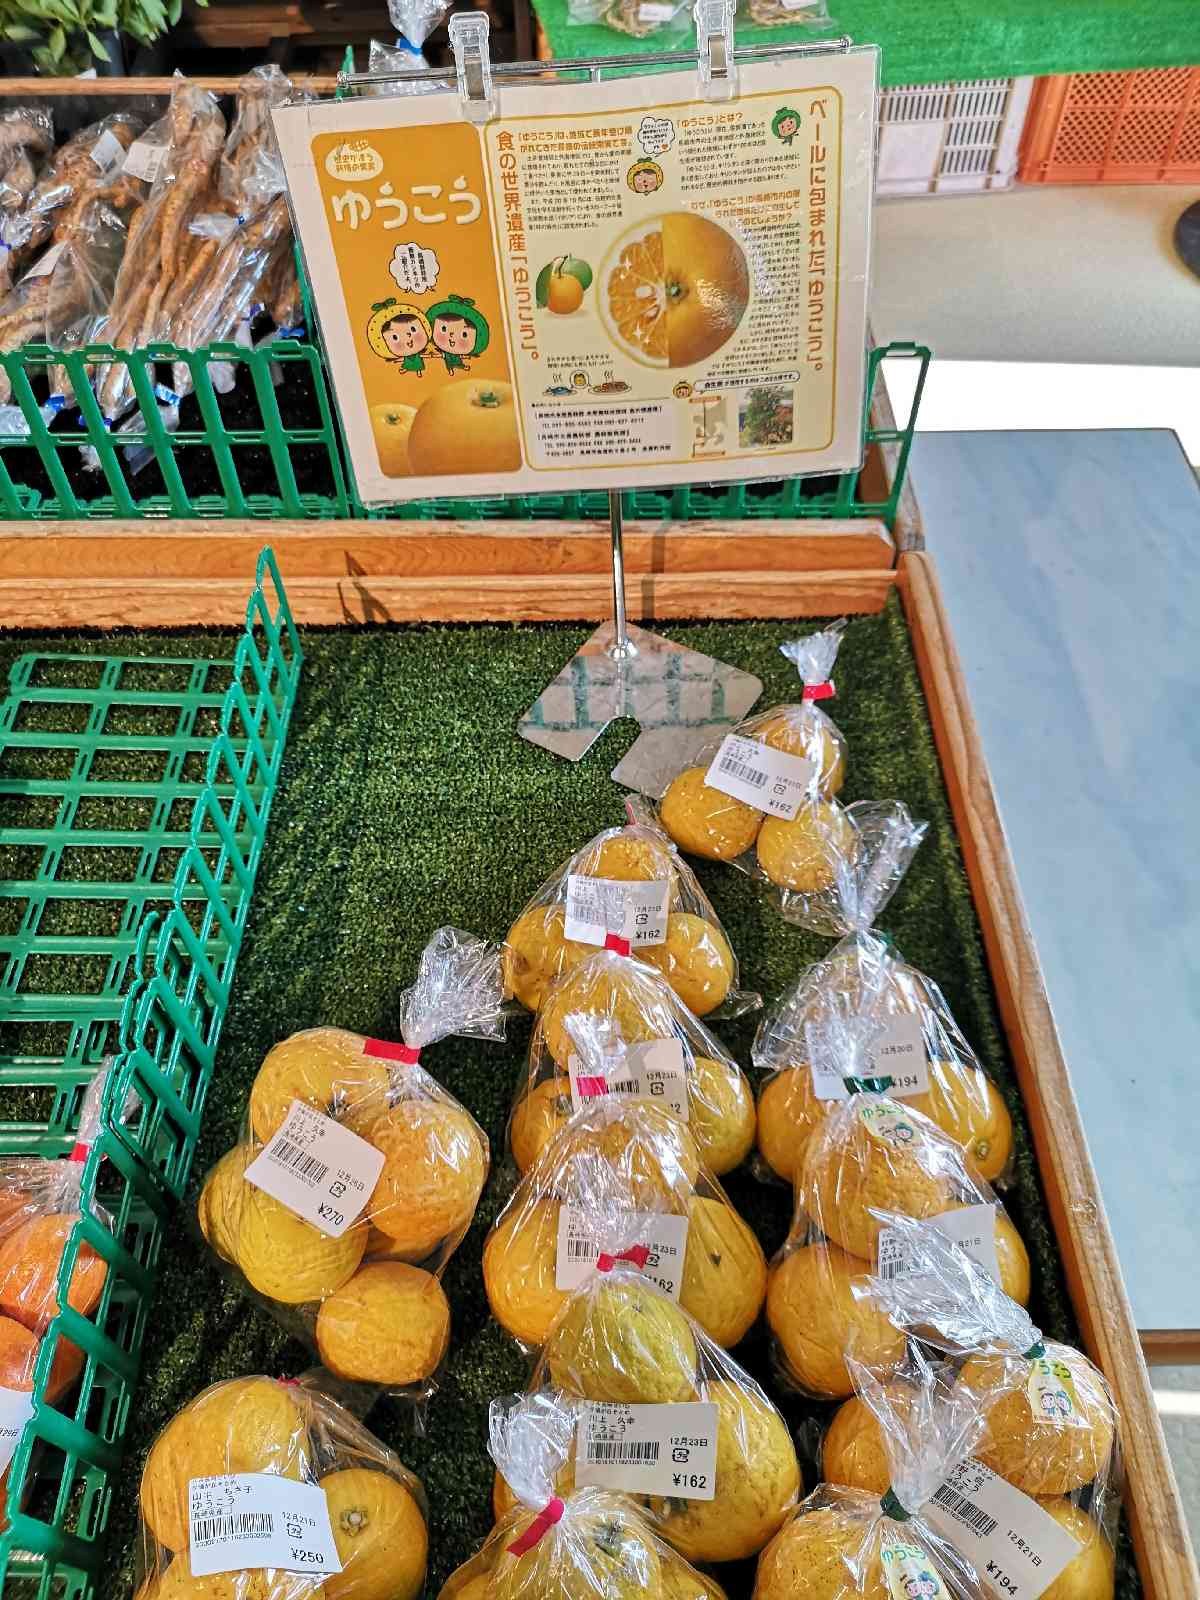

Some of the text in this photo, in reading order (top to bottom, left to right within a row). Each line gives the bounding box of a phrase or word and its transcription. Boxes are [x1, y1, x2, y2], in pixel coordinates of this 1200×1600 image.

[331, 175, 482, 230] ゆうこう
[807, 99, 826, 371] ベールに包まれた「ゆうこう」。
[496, 130, 540, 361] 食の世界遺産「ゆうこう」。
[768, 799, 792, 814] ¥162
[635, 929, 661, 941] ¥162
[318, 1201, 345, 1227] ¥270
[1039, 1359, 1072, 1379] うこう
[670, 1436, 709, 1448] 12月23日
[672, 1472, 708, 1489] ¥162
[191, 1495, 236, 1511] ゆうこう
[282, 1511, 317, 1528] 12月21日
[290, 1547, 325, 1565] ¥250
[1006, 1529, 1043, 1568] 12月21日
[985, 1558, 1020, 1597] ¥194
